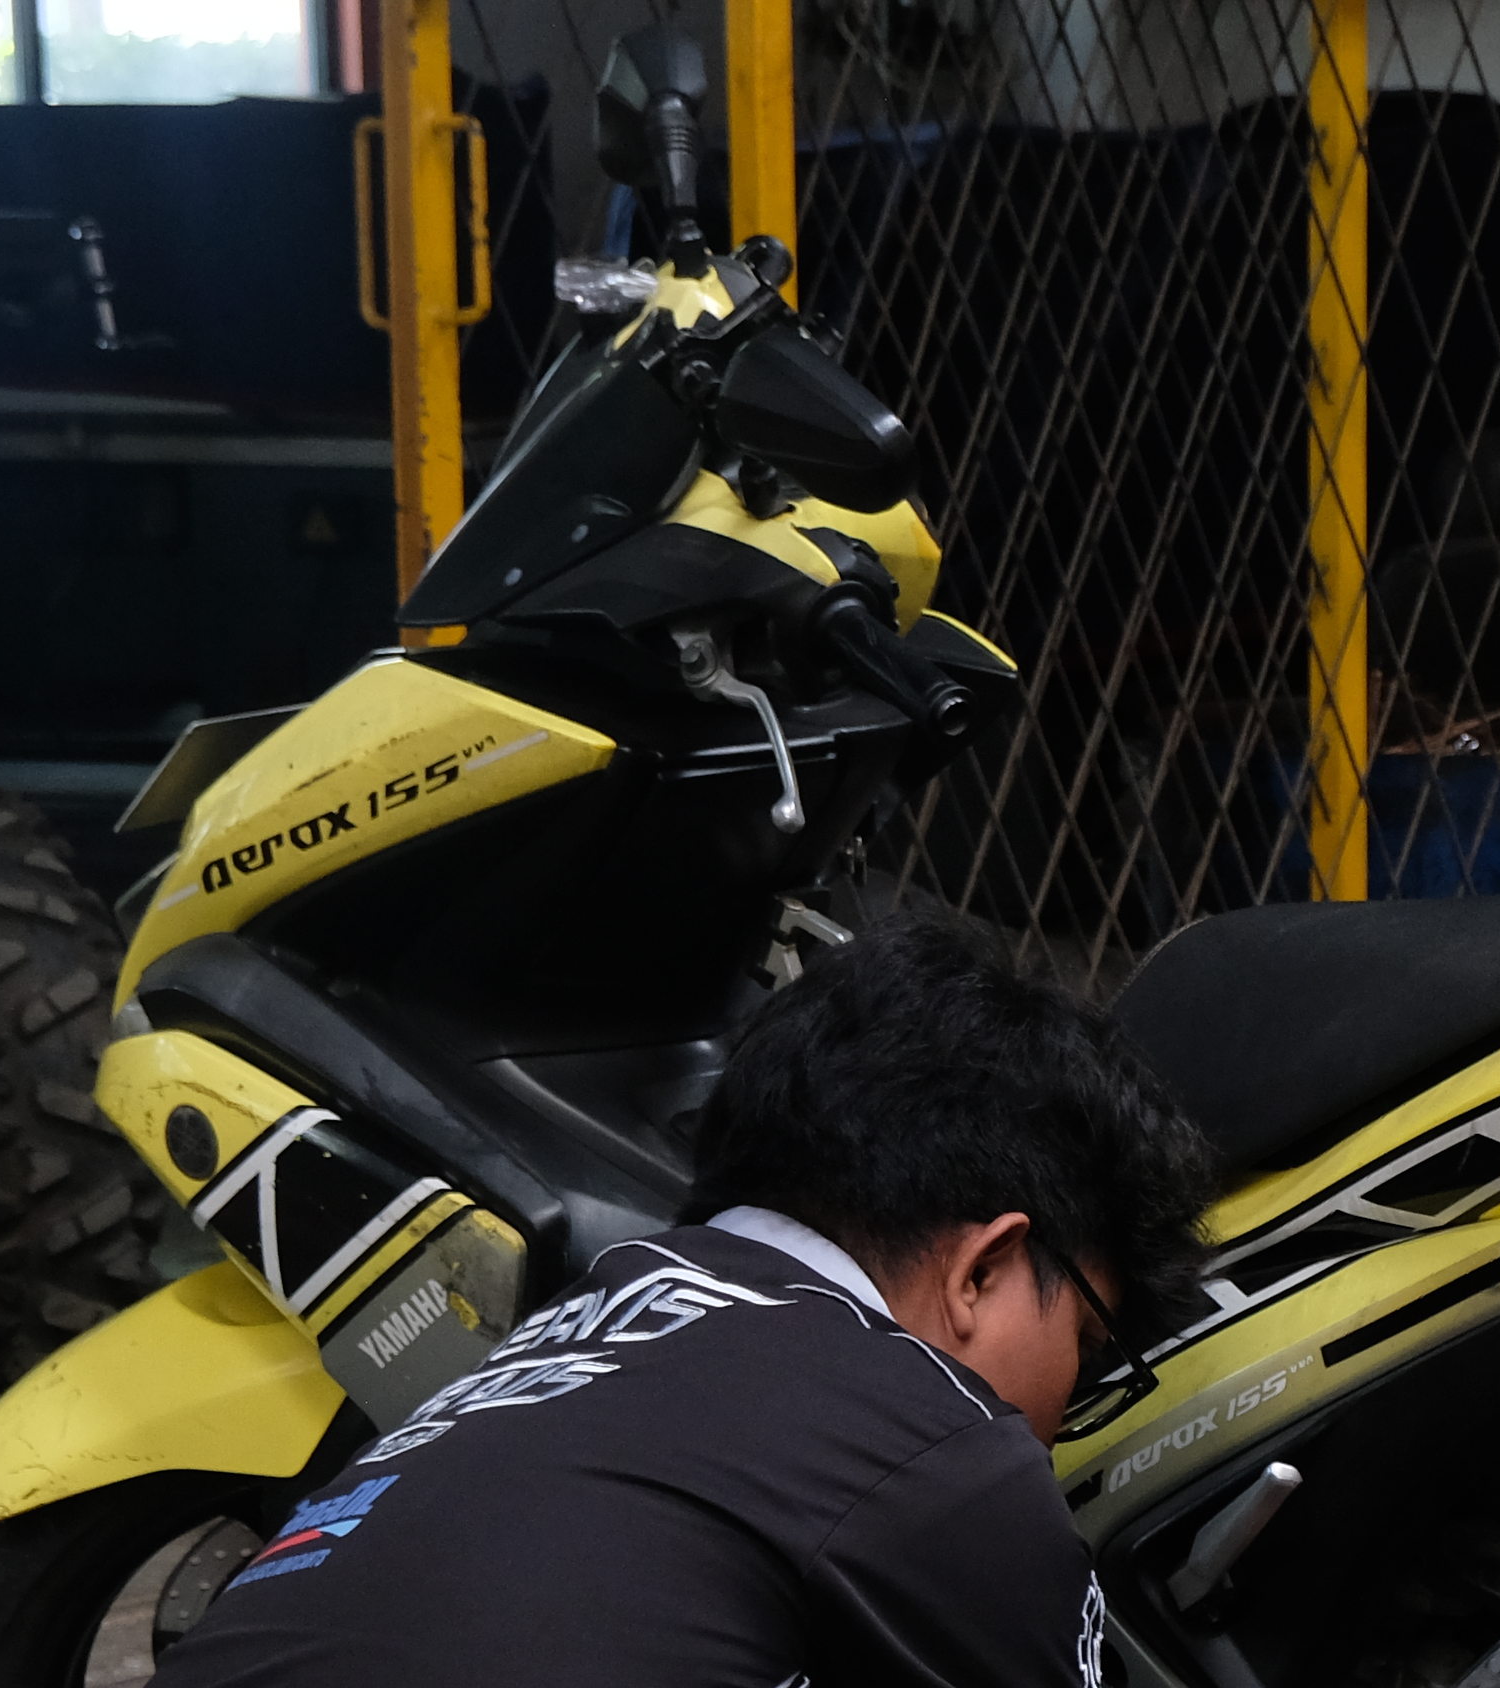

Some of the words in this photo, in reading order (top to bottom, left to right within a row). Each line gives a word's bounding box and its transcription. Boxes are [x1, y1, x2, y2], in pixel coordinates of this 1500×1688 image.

[368, 754, 460, 820] 155
[358, 1278, 449, 1369] YAMAHA
[488, 1267, 799, 1361] ERVIS
[1226, 1370, 1288, 1421] 155
